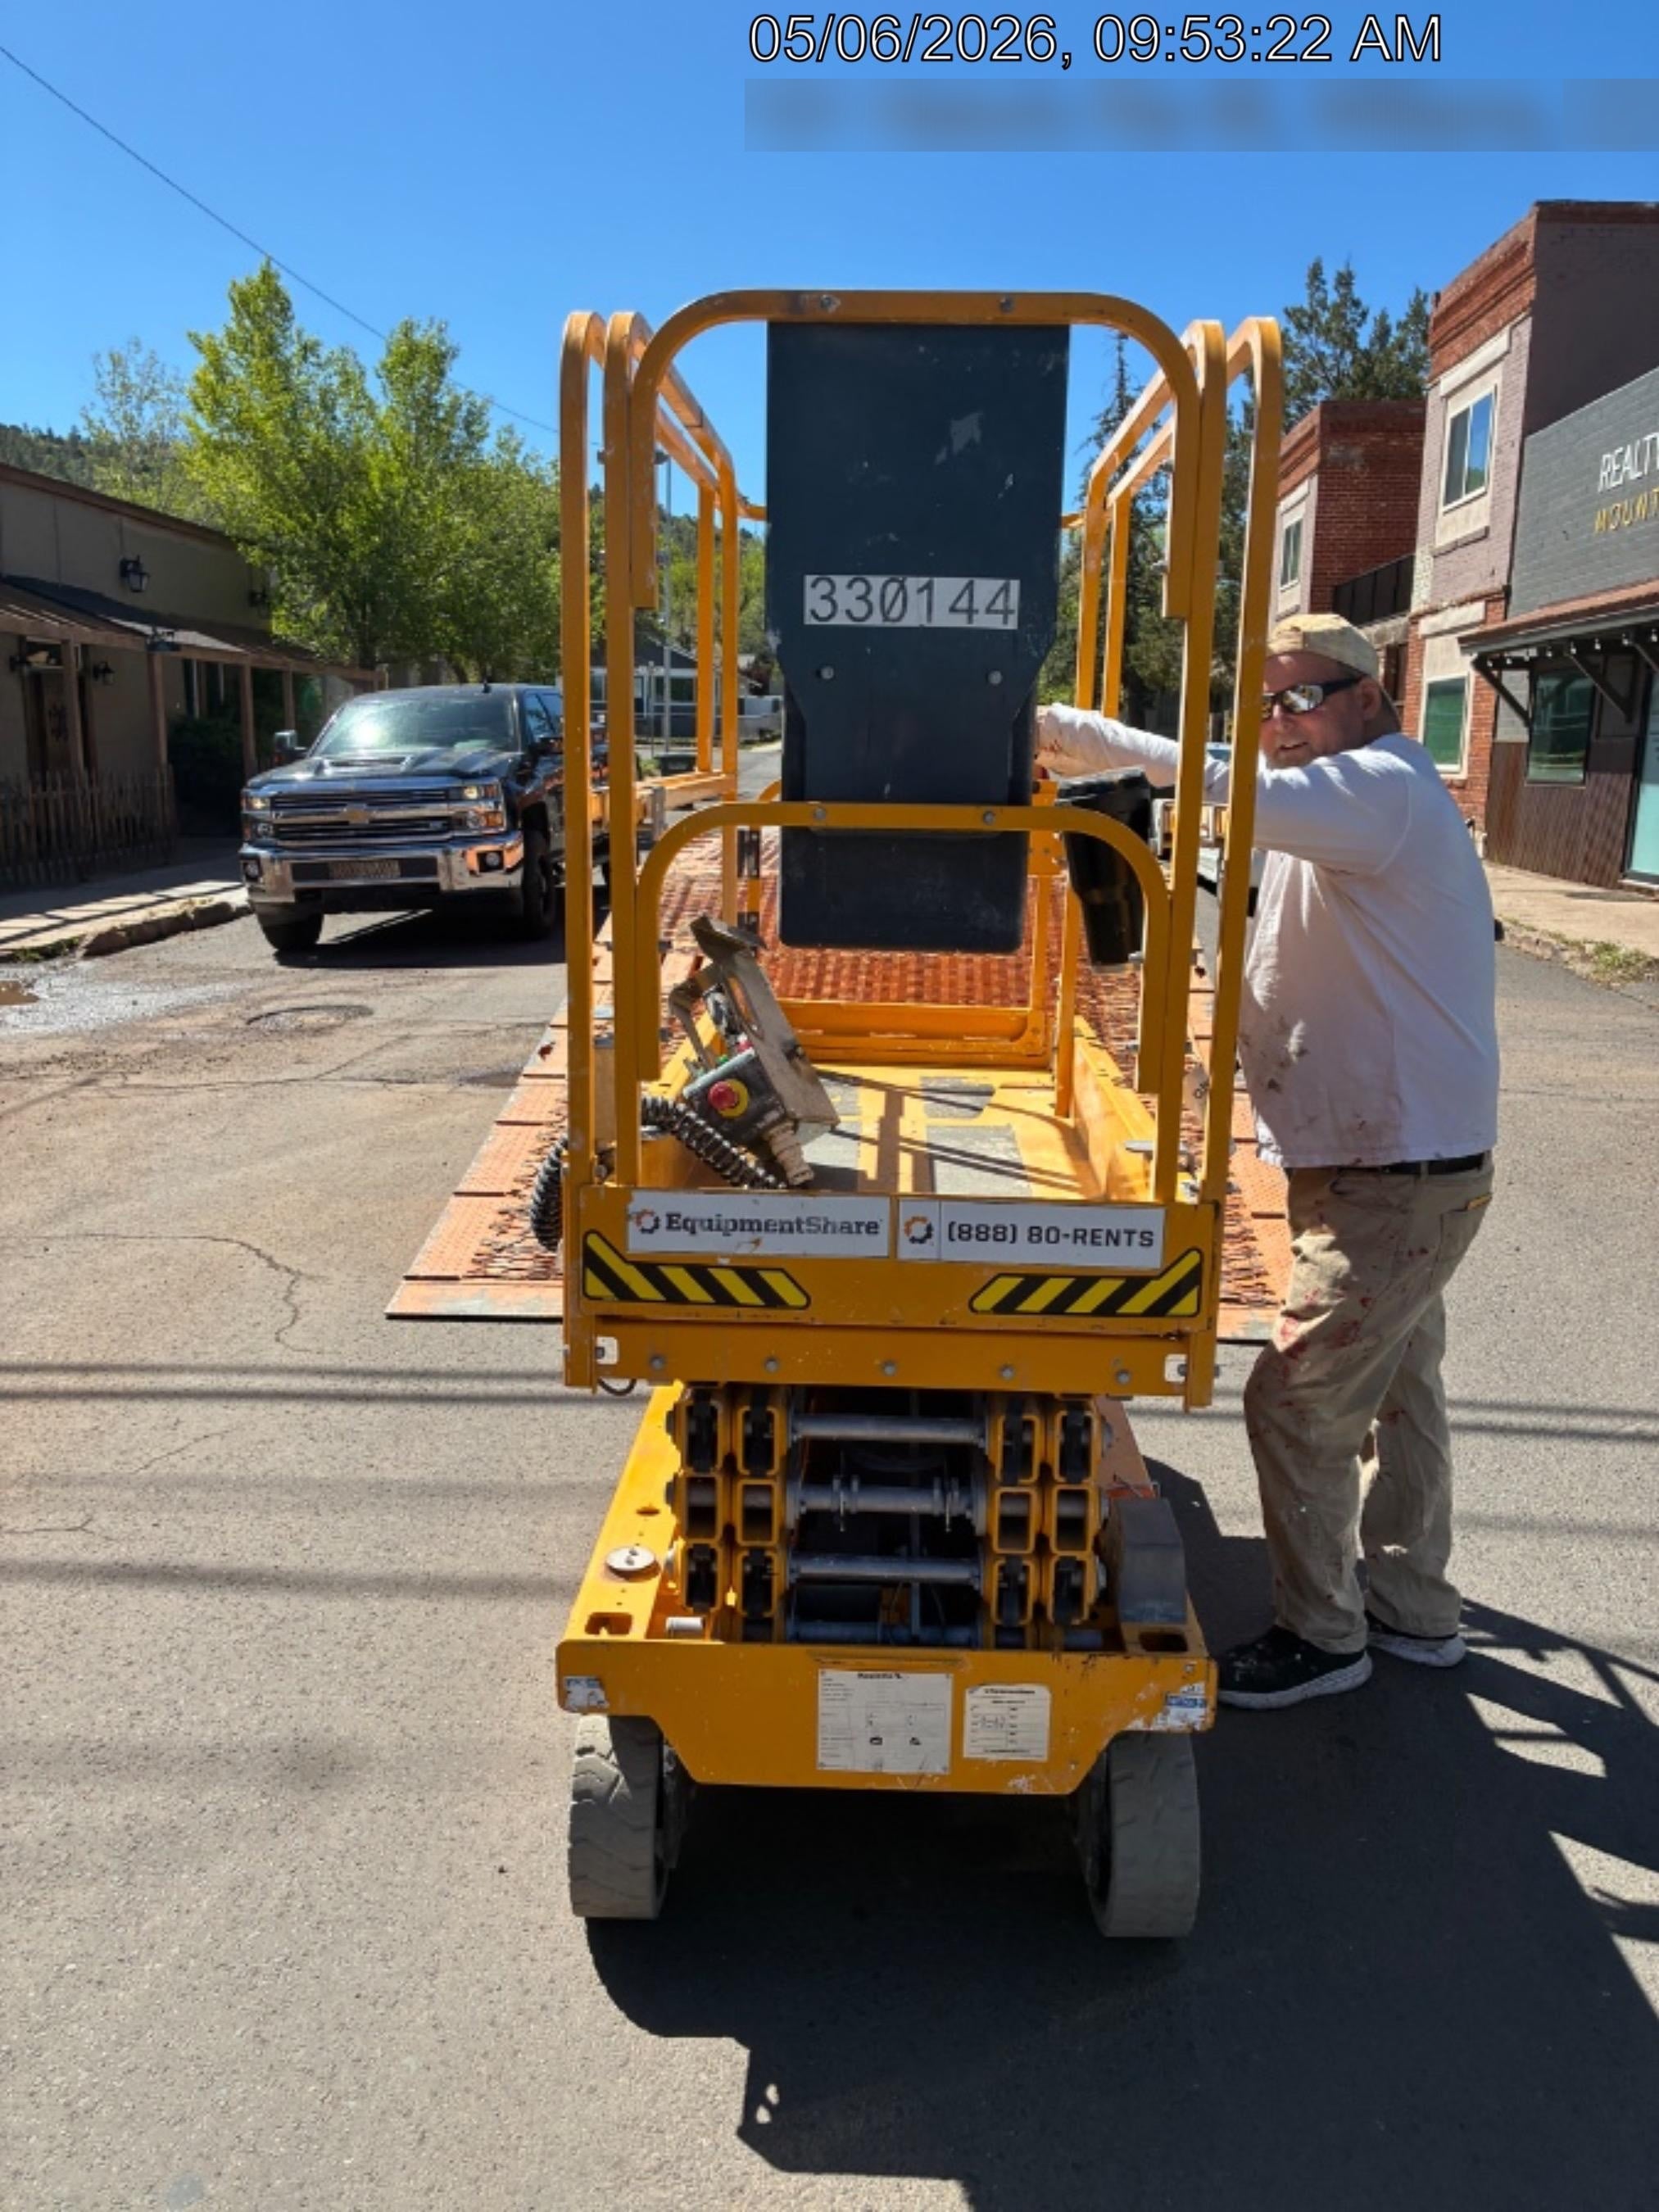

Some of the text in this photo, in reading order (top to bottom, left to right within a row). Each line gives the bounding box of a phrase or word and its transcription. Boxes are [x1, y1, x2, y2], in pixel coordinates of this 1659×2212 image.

[1598, 433, 1659, 492] REALT
[809, 577, 1016, 624] 330144
[665, 1213, 880, 1235] EquipmentShare
[948, 1221, 1154, 1247] (888) 80-RENTS
